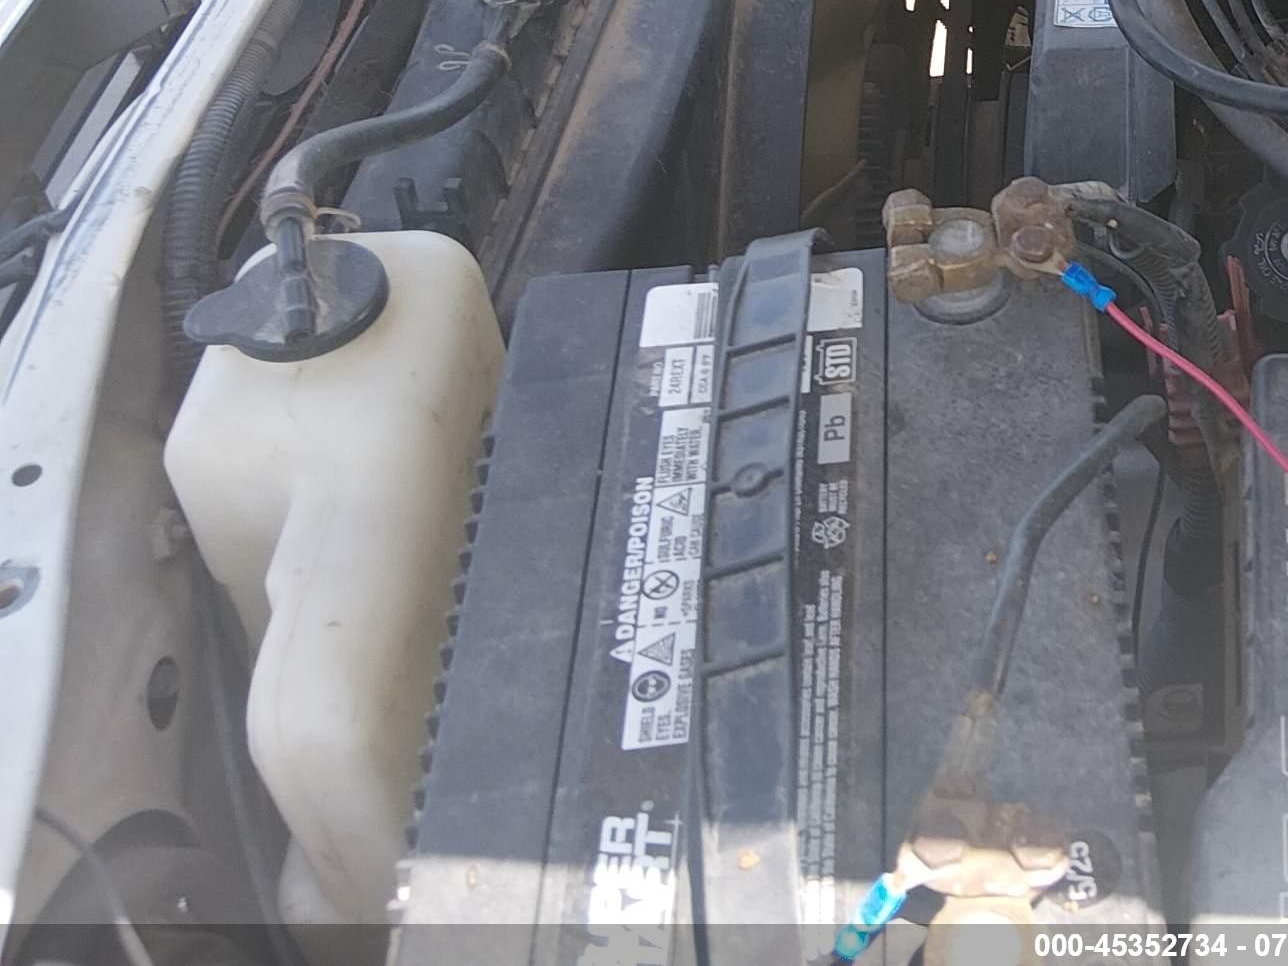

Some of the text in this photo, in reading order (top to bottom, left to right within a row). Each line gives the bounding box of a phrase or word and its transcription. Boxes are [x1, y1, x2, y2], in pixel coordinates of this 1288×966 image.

[824, 344, 851, 379] STD
[823, 414, 846, 442] Pb
[657, 434, 674, 484] FLUSH EYES
[669, 425, 689, 483] IMMEDIATELY
[686, 458, 699, 482] WITH
[657, 515, 675, 559] SULFURIC
[674, 535, 687, 557] ACID
[690, 538, 702, 556] CAN
[615, 475, 654, 640] DANGER/POISON
[638, 706, 655, 743] SHIELD
[672, 683, 692, 739] EXPLOSIVE
